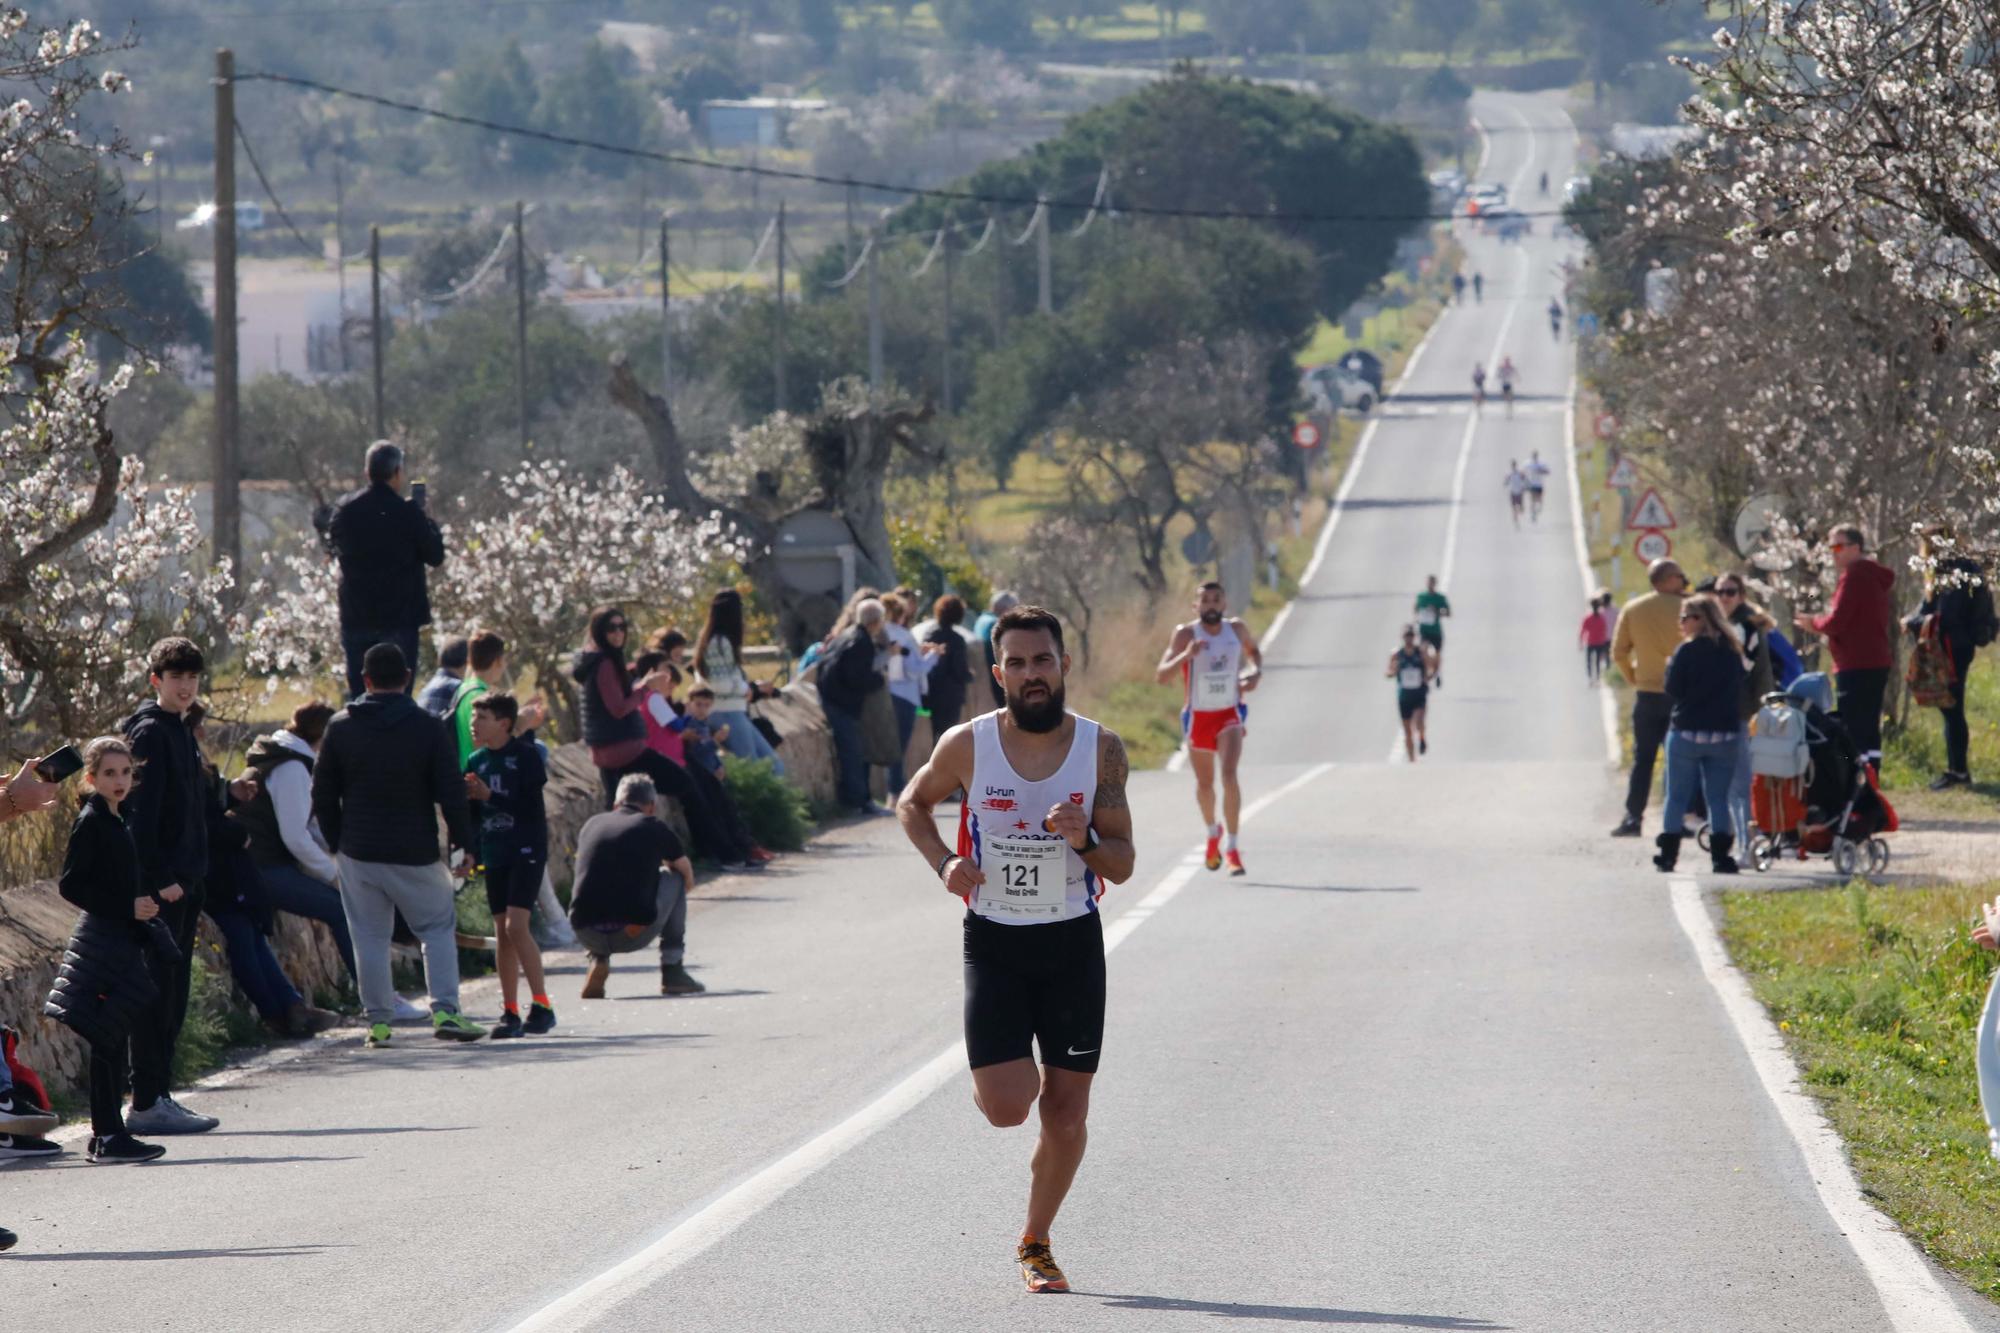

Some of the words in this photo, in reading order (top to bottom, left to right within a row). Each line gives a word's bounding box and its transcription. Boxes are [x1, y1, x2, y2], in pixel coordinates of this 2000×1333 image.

[986, 786, 1015, 797] U-run
[1002, 864, 1038, 886] 121
[1005, 887, 1021, 896] David
